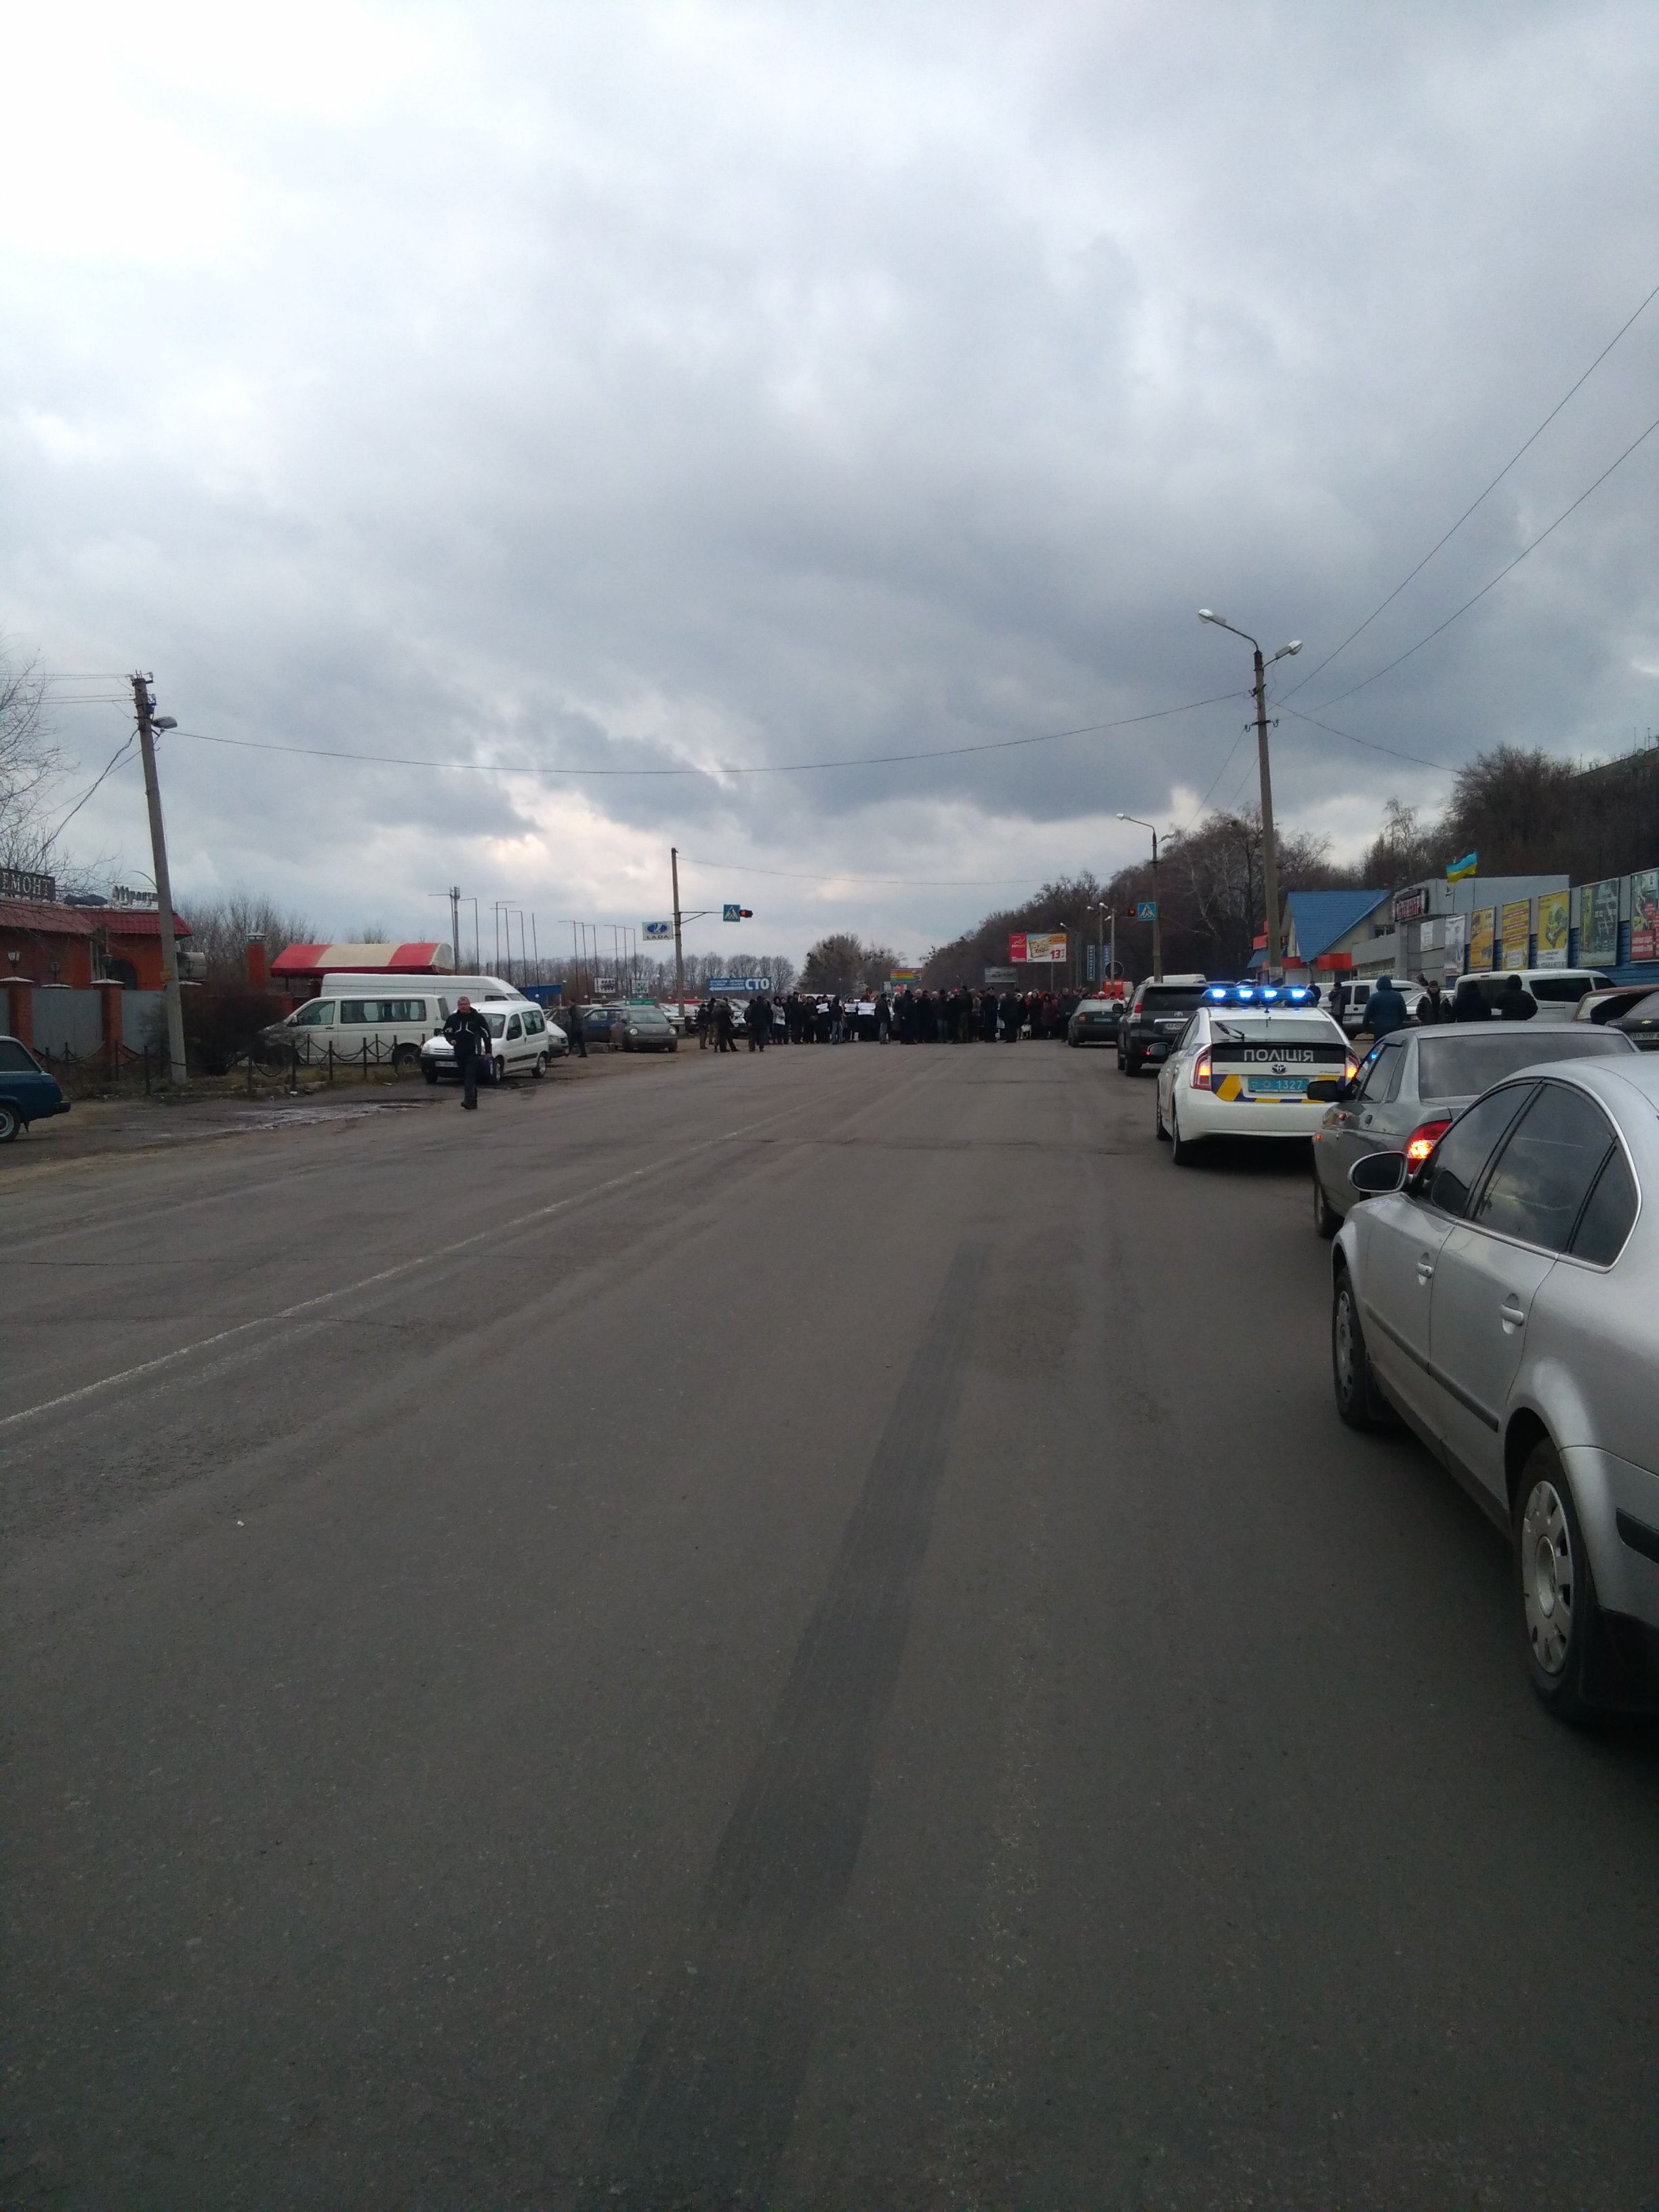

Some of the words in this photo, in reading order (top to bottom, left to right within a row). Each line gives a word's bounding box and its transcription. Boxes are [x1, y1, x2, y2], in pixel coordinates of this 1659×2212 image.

[1050, 949, 1061, 960] 13
[745, 978, 770, 990] СТО
[1244, 1049, 1314, 1062] ПОЛІЦІЯ
[1276, 1080, 1303, 1090] 1327
